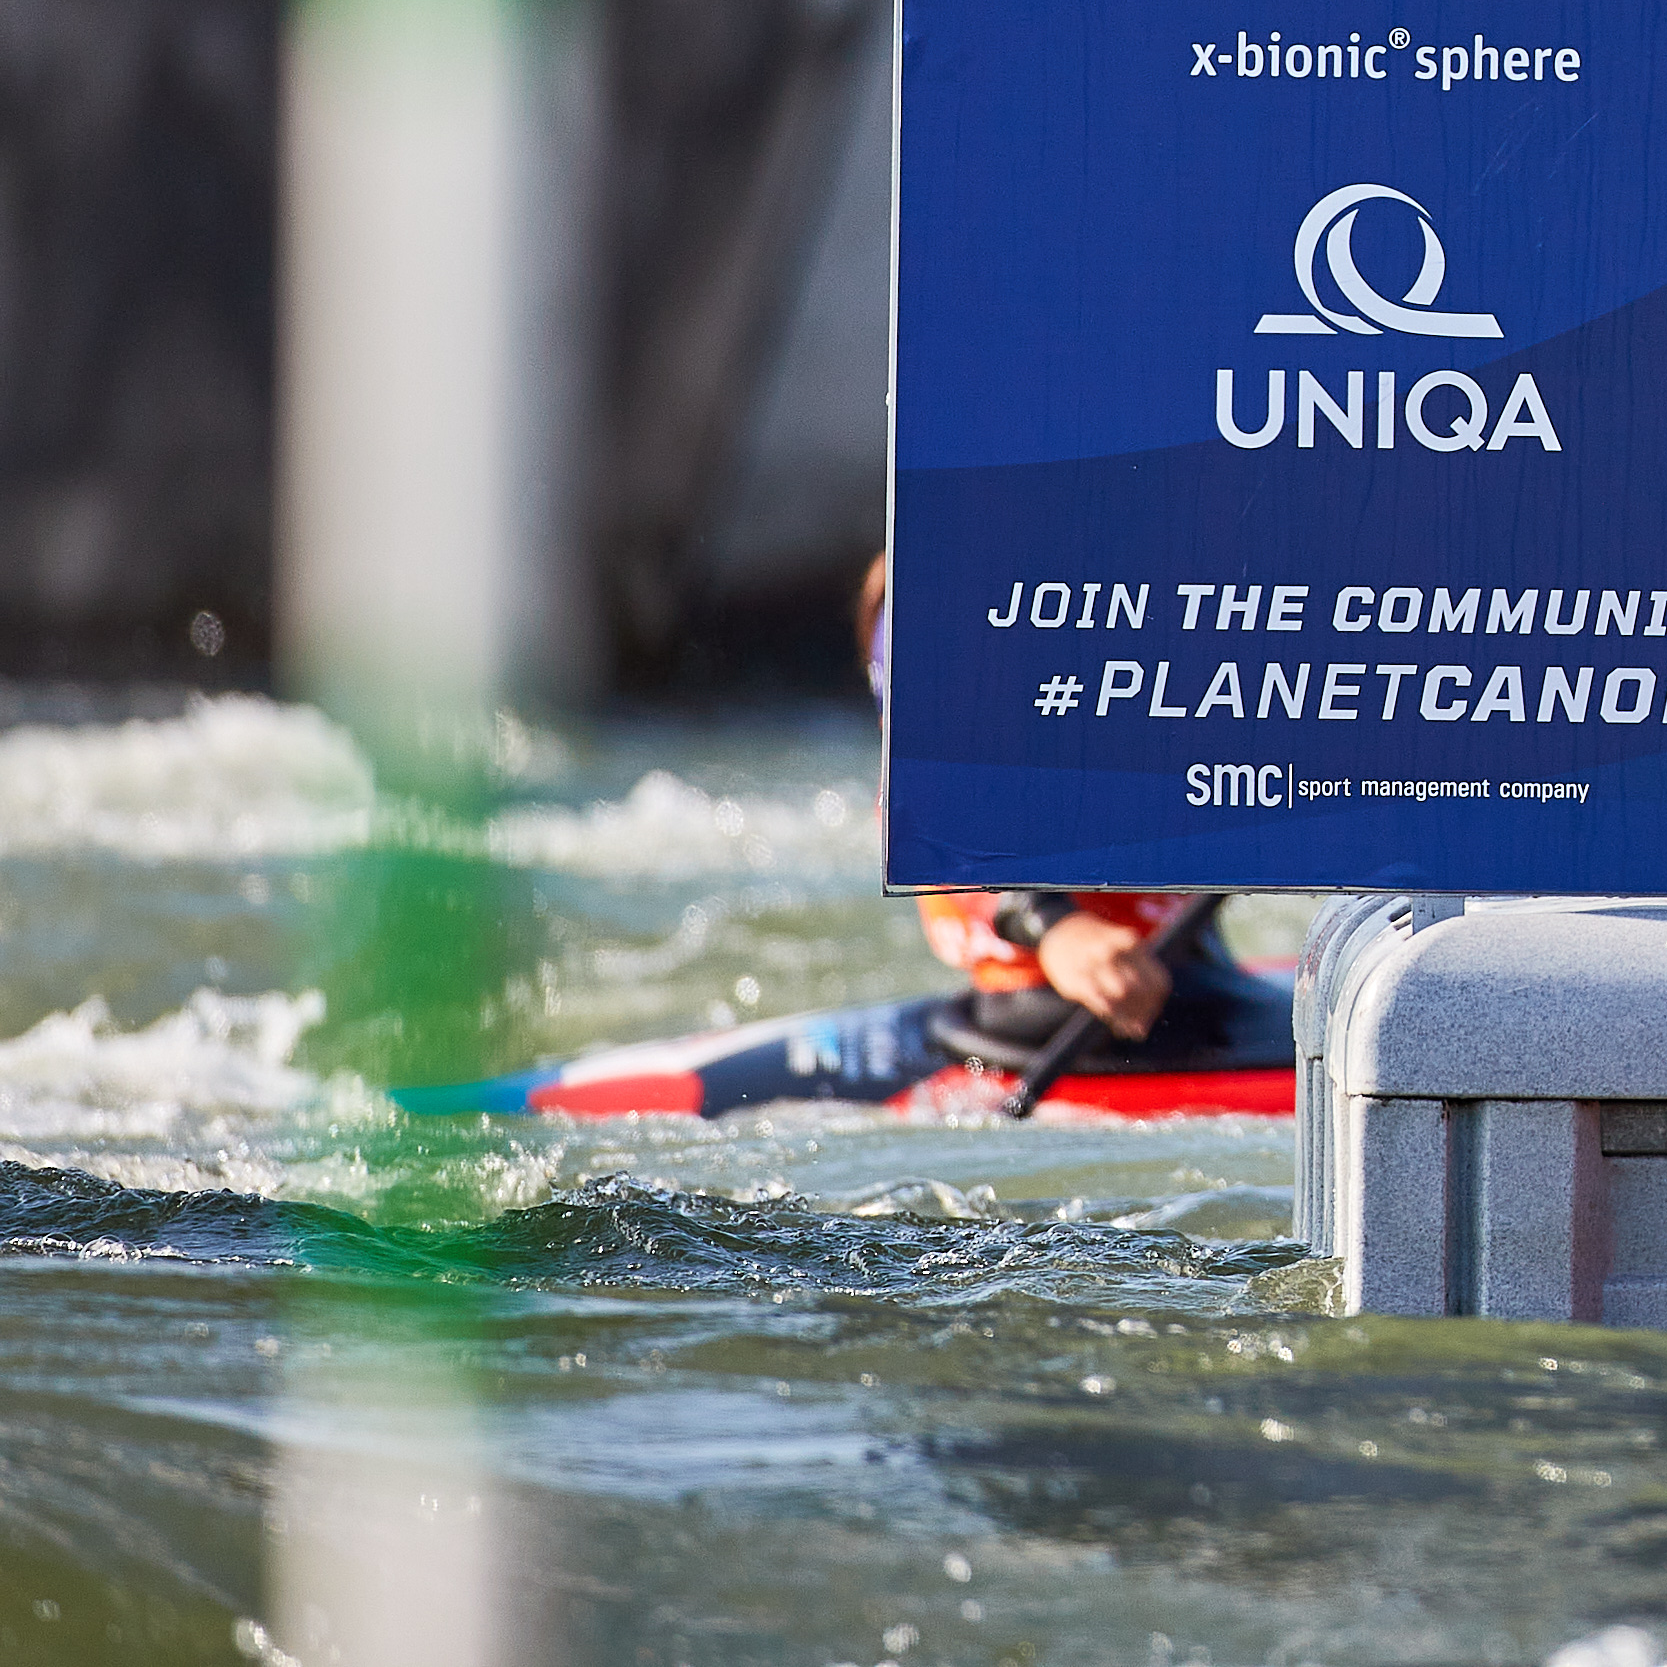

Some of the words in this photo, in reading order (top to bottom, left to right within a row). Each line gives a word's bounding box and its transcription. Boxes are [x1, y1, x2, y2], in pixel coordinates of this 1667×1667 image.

[1414, 34, 1581, 91] sphere
[1216, 368, 1563, 452] UNIQA
[987, 582, 1150, 629] JOIN
[1176, 584, 1310, 631] THE
[1298, 778, 1352, 801] sport
[1361, 779, 1491, 802] management
[1499, 782, 1590, 804] company
